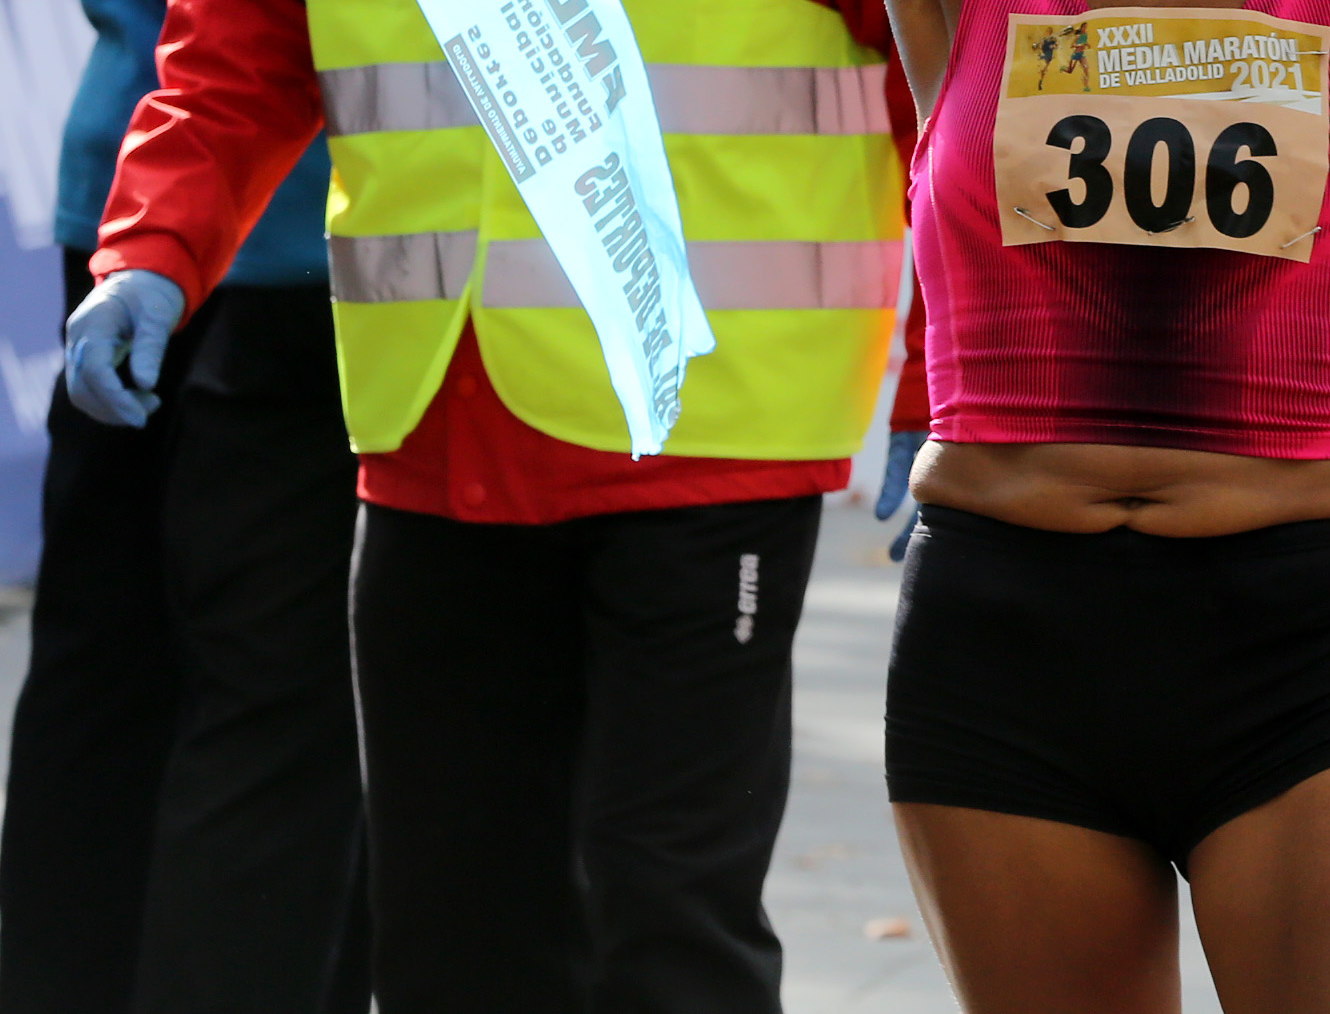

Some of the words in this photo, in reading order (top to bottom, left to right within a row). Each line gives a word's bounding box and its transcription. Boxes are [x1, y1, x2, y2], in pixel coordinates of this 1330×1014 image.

[1097, 23, 1154, 48] XXXII
[1098, 44, 1181, 73] MEDIA
[1183, 32, 1298, 66] MARATÓN
[1100, 73, 1121, 89] DE
[1125, 63, 1225, 86] VALLADOLID
[1230, 61, 1304, 92] 2021
[1045, 114, 1278, 239] 306
